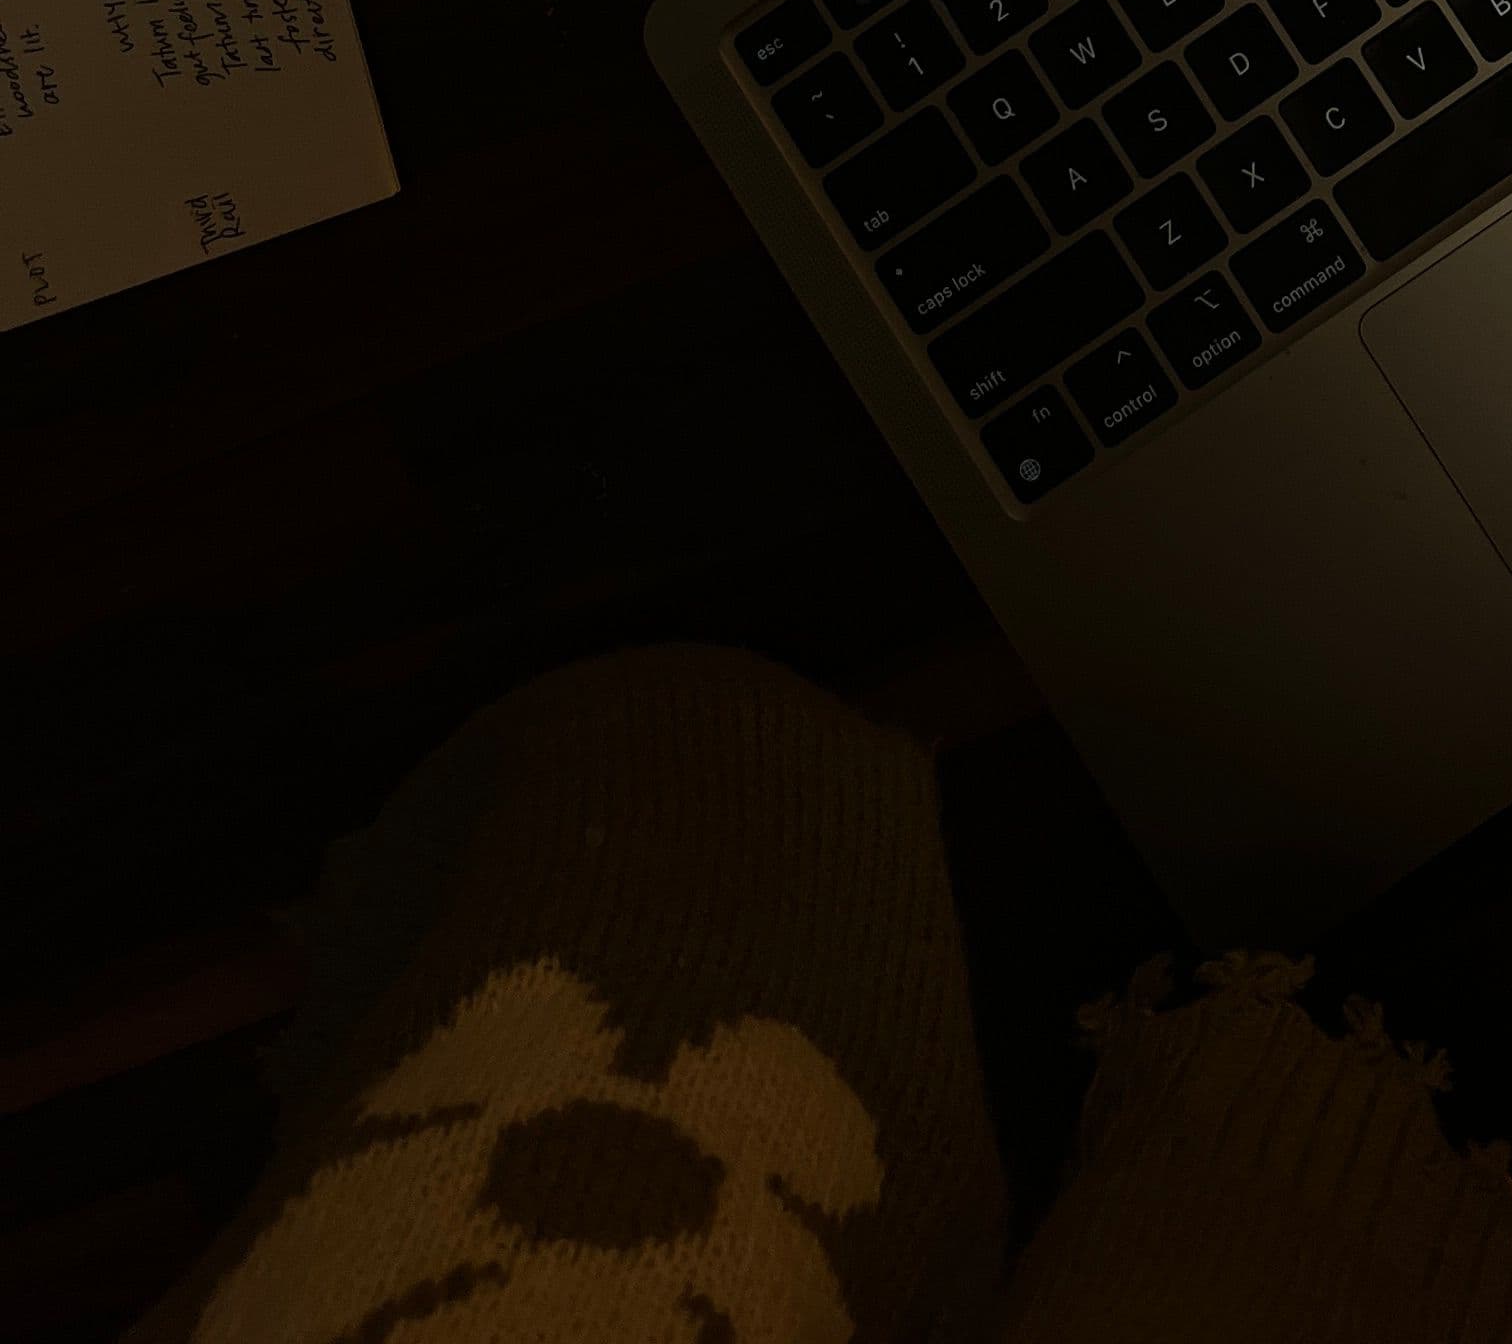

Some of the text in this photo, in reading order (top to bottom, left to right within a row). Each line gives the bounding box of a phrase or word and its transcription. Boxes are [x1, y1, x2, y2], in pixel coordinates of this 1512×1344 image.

[756, 37, 784, 61] esc
[991, 96, 1017, 120] Q
[1068, 35, 1096, 65] W
[863, 209, 890, 232] tab
[21, 251, 57, 306] PLOT
[916, 263, 987, 315] caps lock
[1272, 254, 1346, 313] command
[1191, 329, 1242, 368] option
[969, 369, 1007, 400] shift
[1103, 383, 1158, 428] control
[1031, 405, 1052, 424] fn
